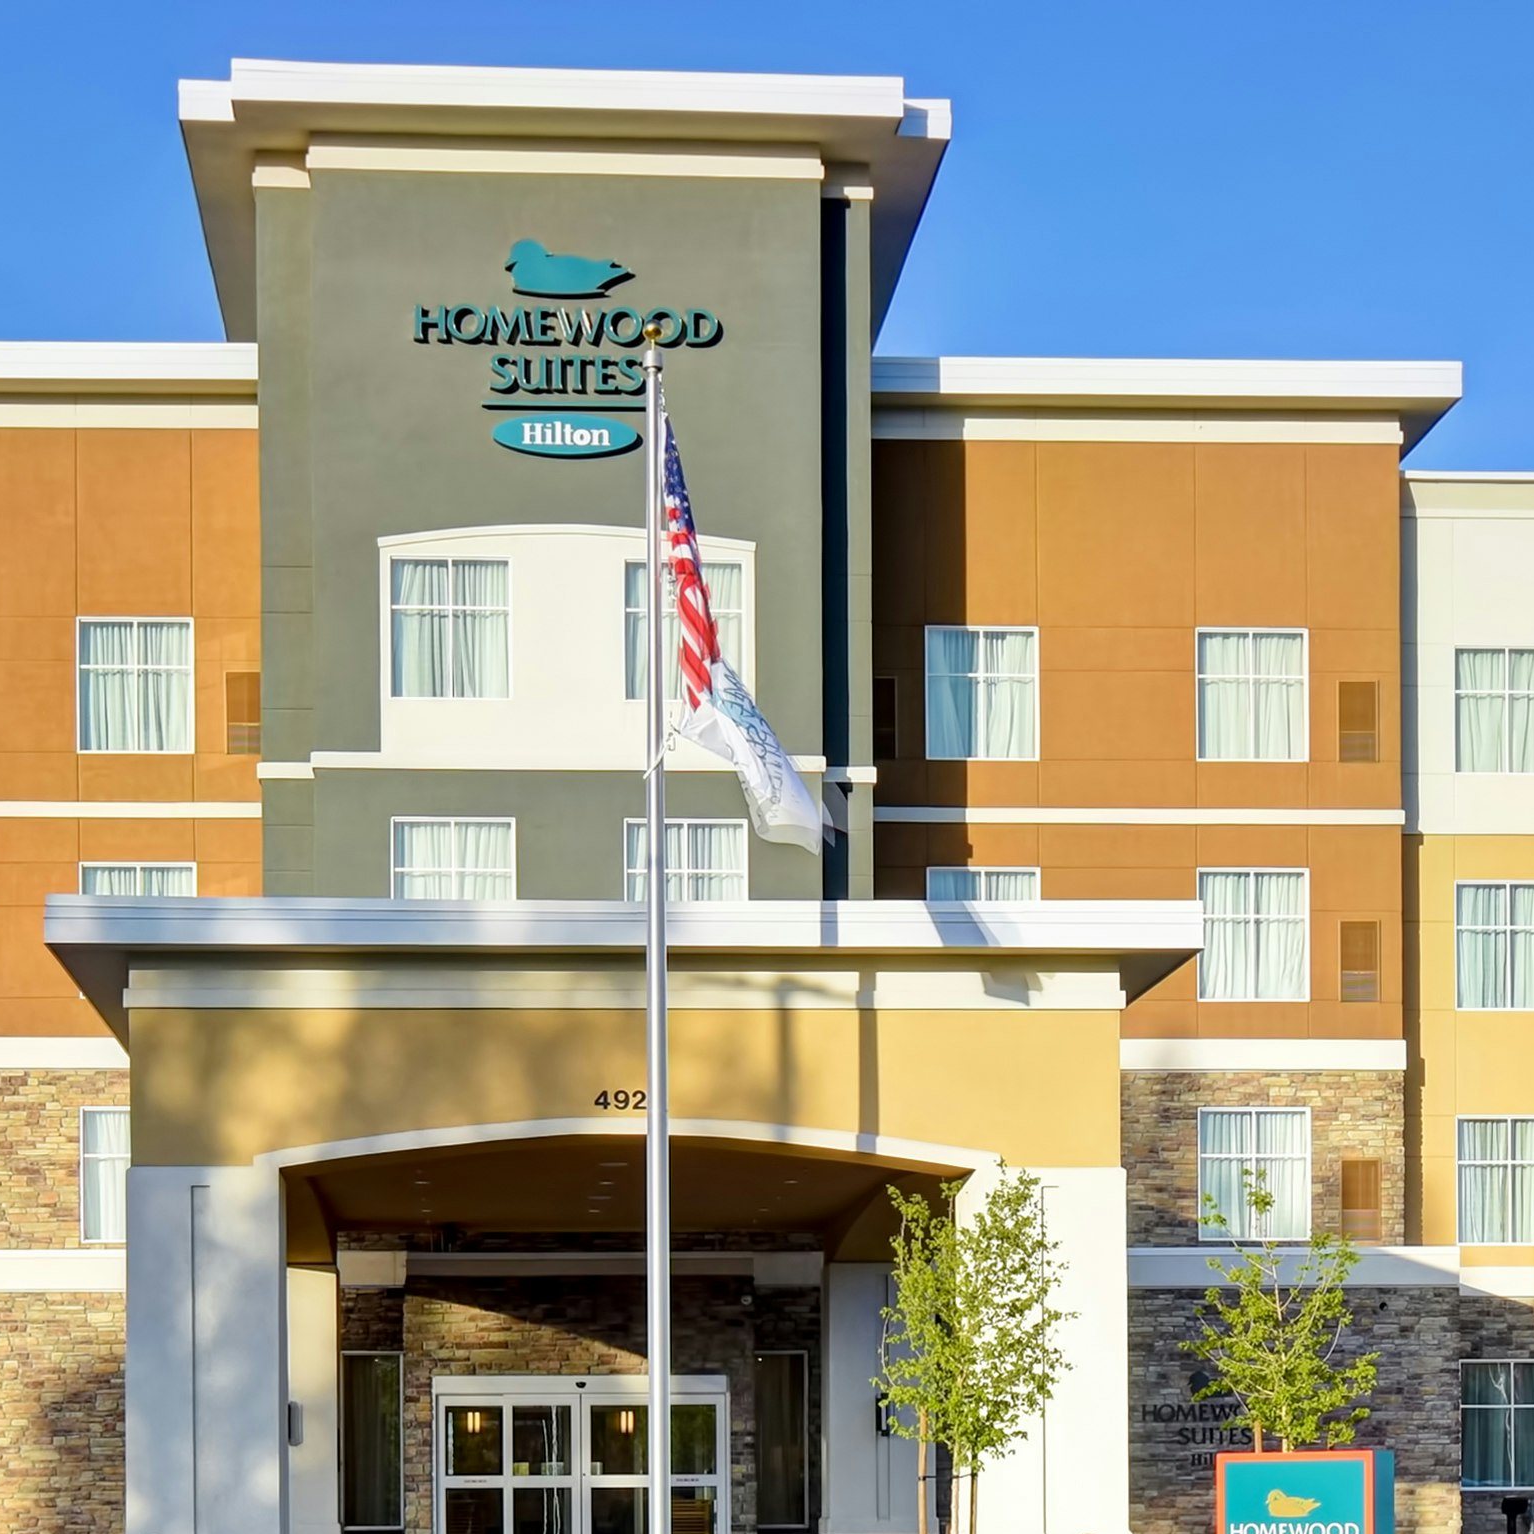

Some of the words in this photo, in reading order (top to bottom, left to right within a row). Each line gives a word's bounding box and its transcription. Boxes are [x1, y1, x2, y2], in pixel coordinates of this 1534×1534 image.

[413, 304, 721, 347] HOMEWOOD
[489, 353, 645, 395] SUITES
[521, 421, 611, 446] Hilton
[1141, 1404, 1246, 1422] HOMEW
